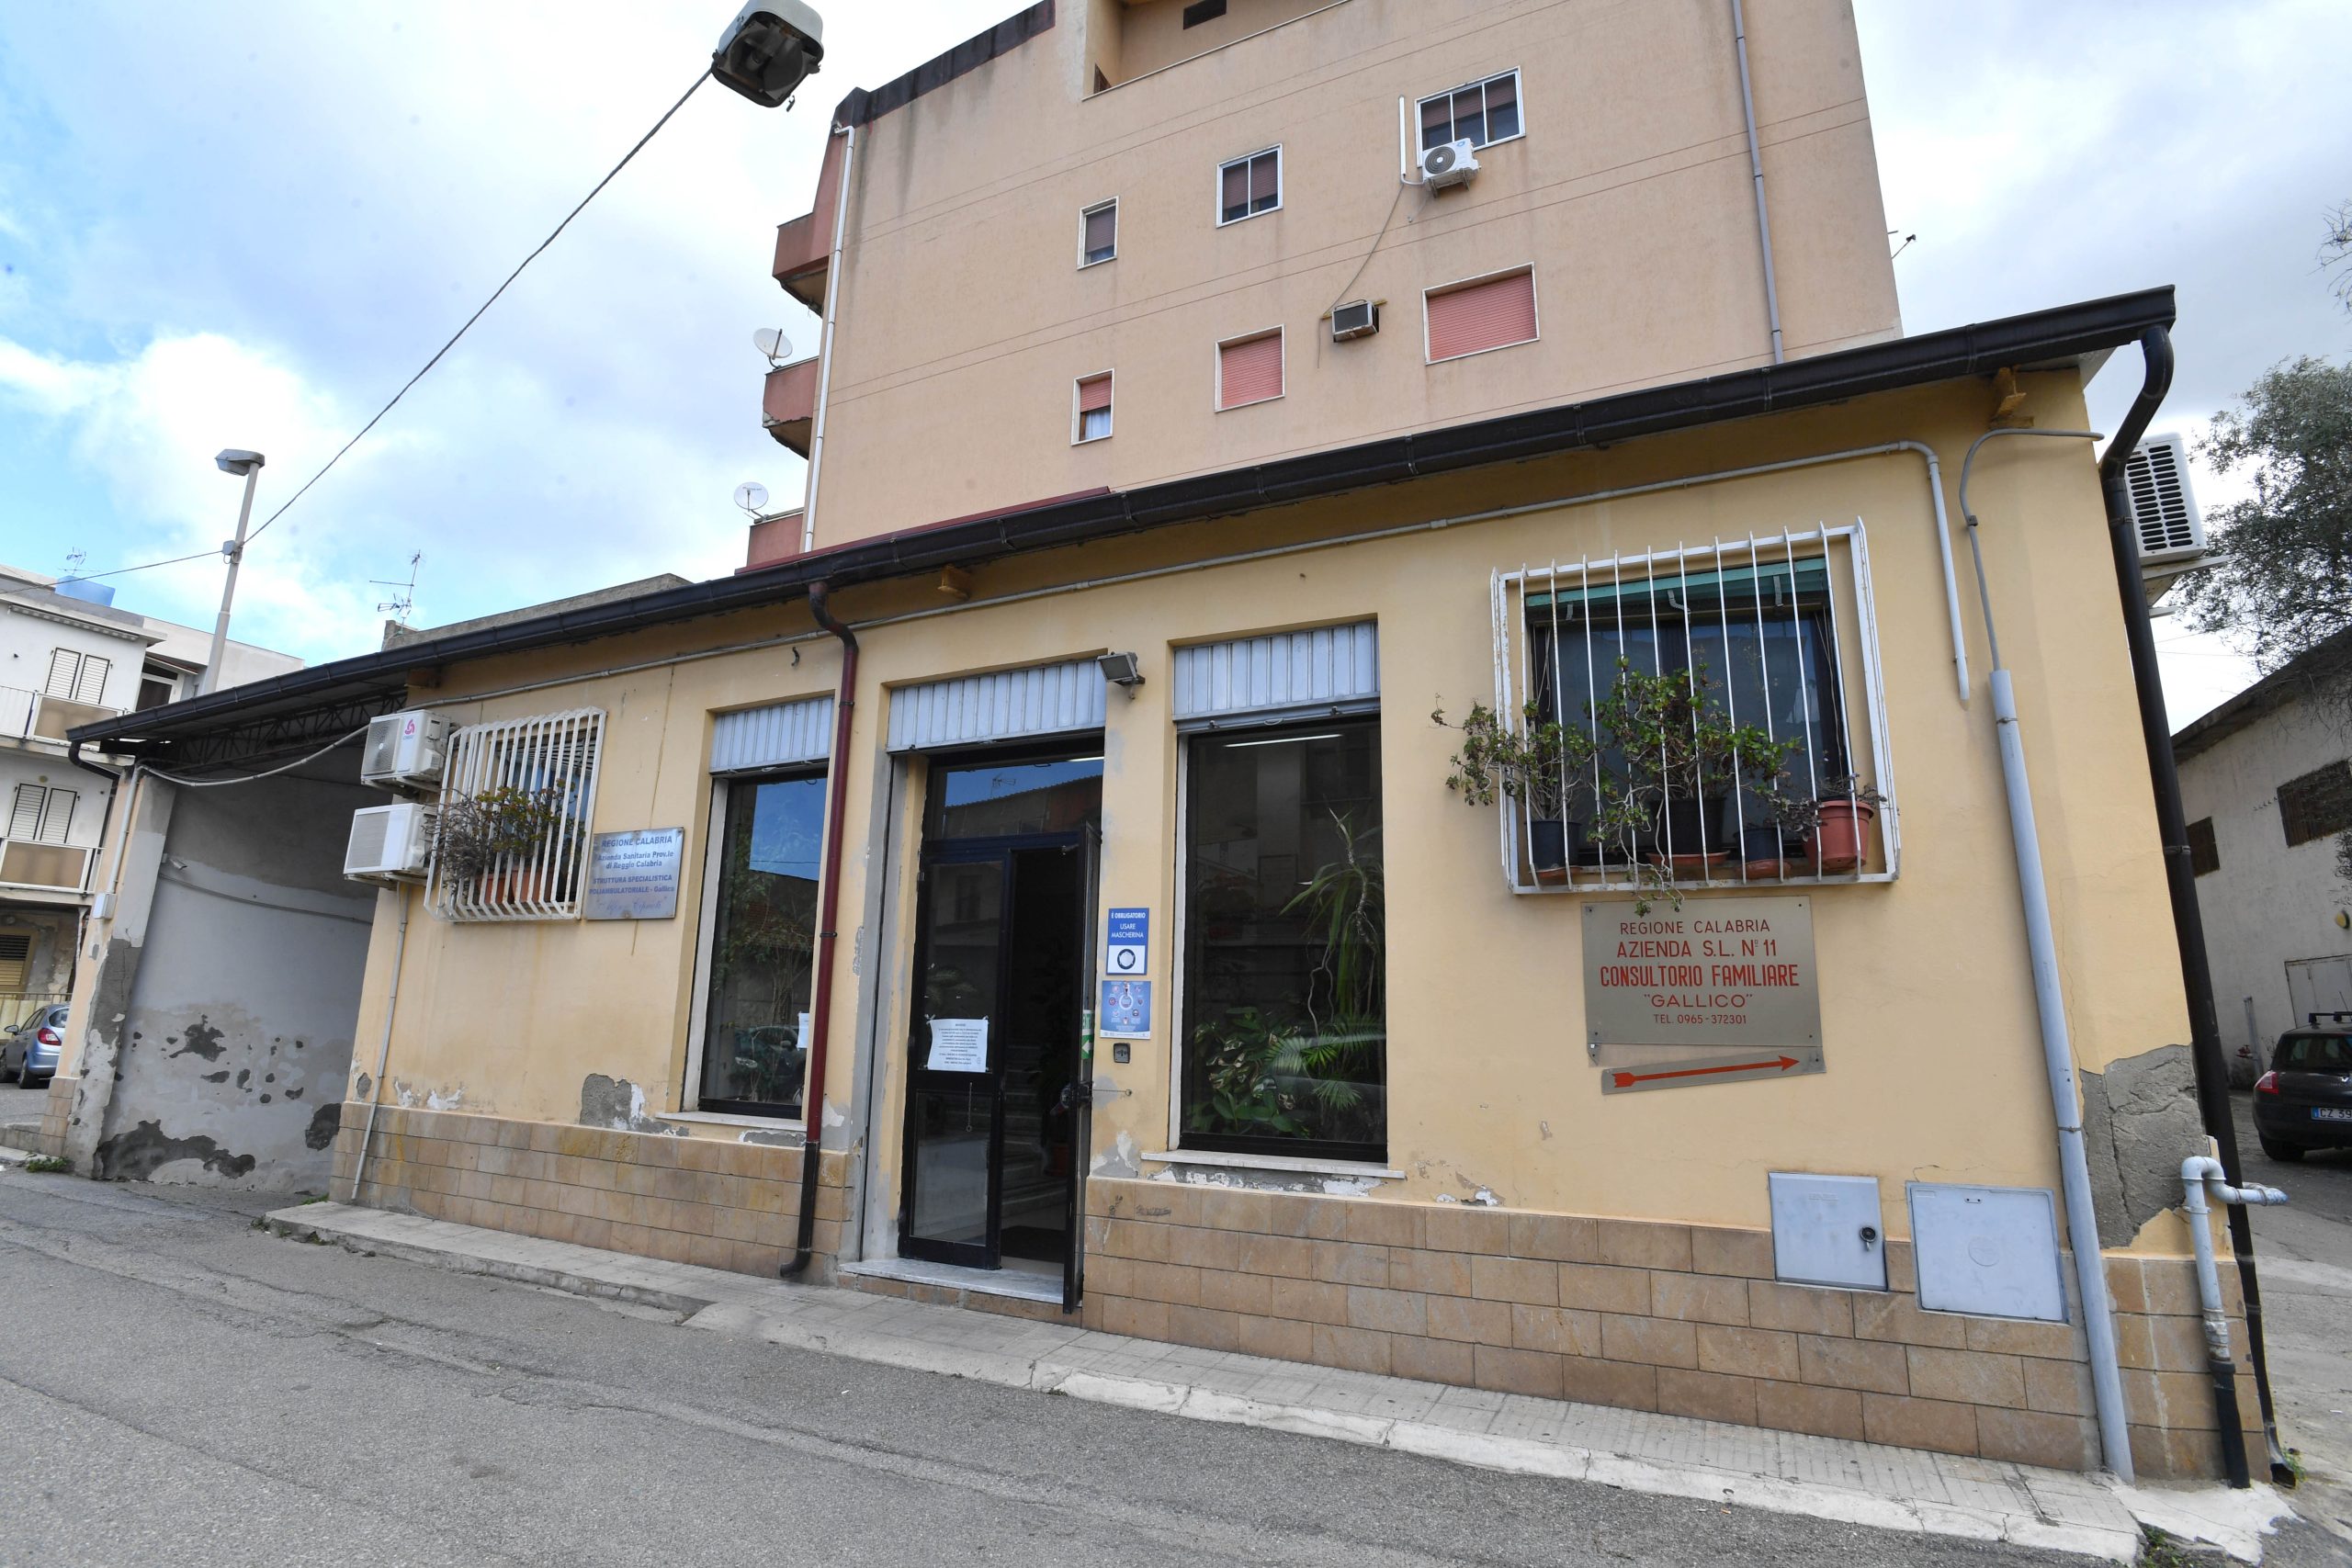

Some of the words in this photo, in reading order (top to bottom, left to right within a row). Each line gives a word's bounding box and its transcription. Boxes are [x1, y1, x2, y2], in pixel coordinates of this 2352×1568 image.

[602, 839, 634, 848] REGIONE
[635, 836, 673, 846] CALABRIA
[623, 851, 651, 860] Sanitaria
[613, 862, 635, 870] Reggio
[636, 860, 662, 868] Calabria
[593, 876, 627, 885] STRUTTURA
[628, 874, 673, 883] SPECIALISTICA
[1620, 920, 1684, 935] REGIONE
[1693, 919, 1770, 933] CALABRIA
[1617, 940, 1691, 958] AZIENDA
[1702, 940, 1735, 957] S.L.
[1763, 939, 1777, 956] 11
[1600, 964, 1703, 987] CONSULTORIO
[1712, 964, 1800, 987] FAMILIARE
[2320, 1108, 2334, 1118] CZ
